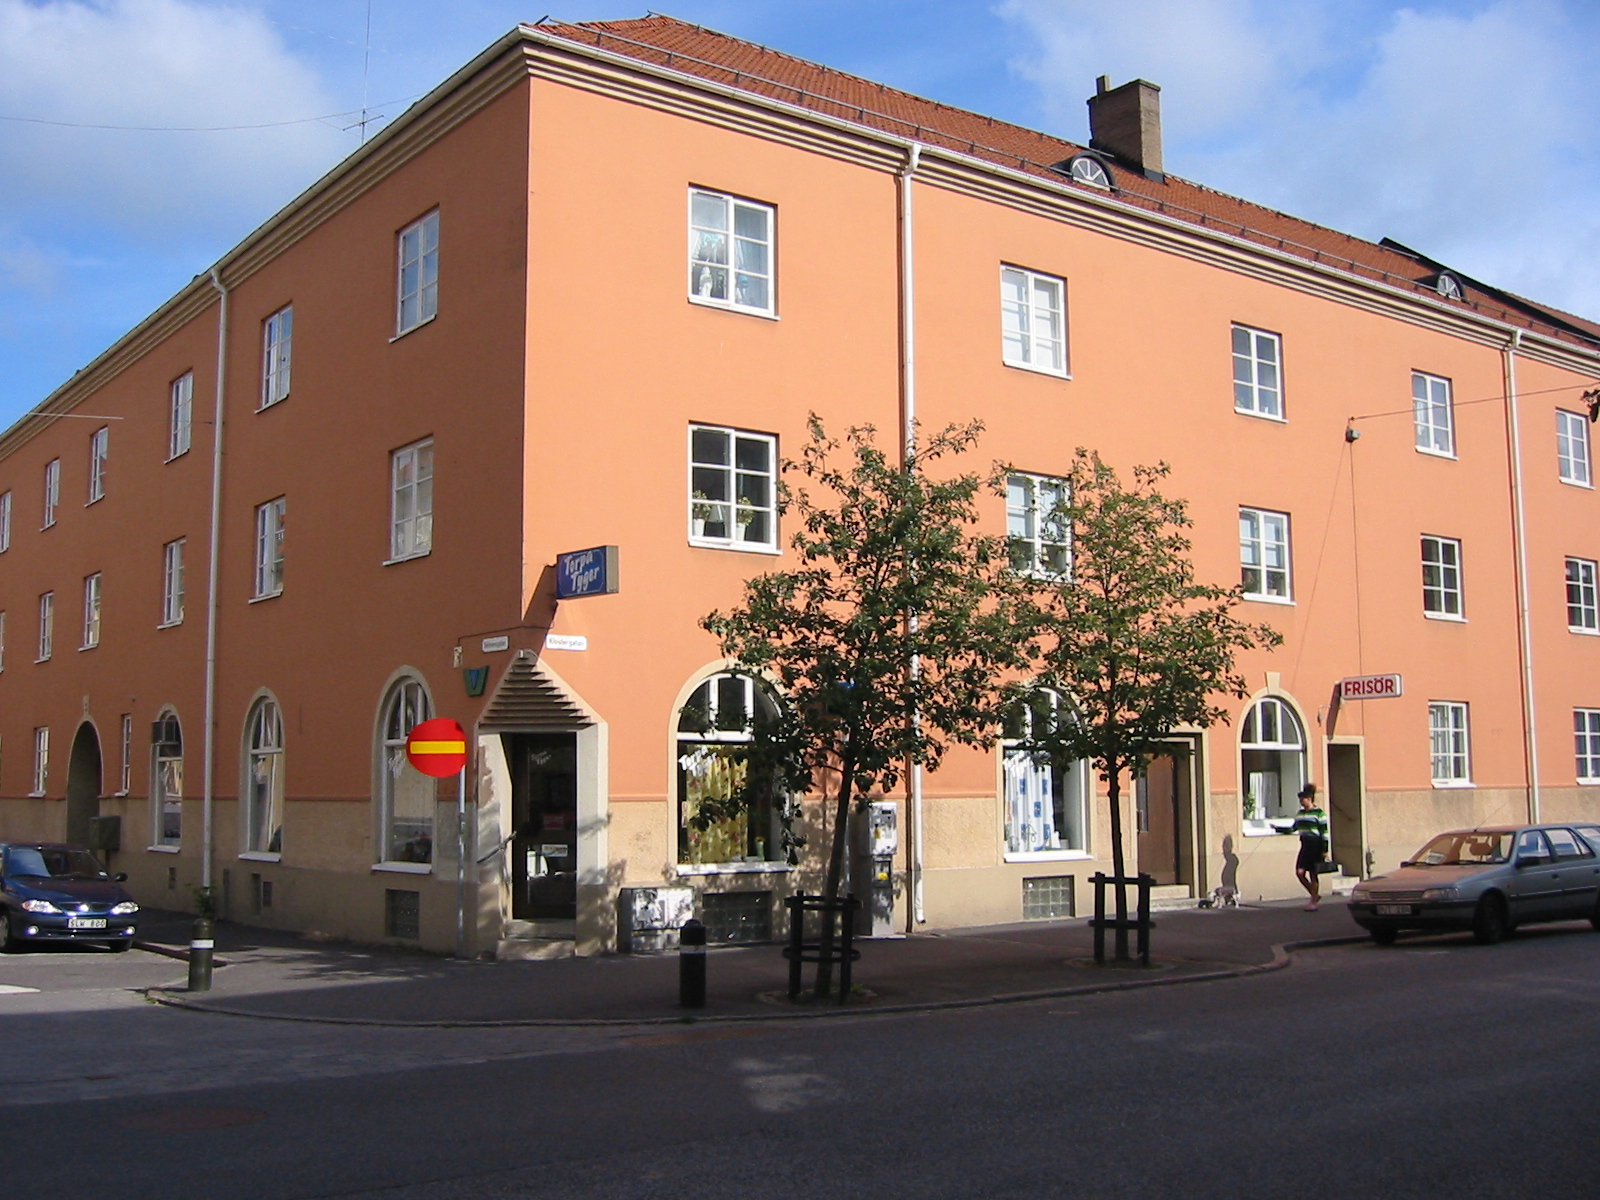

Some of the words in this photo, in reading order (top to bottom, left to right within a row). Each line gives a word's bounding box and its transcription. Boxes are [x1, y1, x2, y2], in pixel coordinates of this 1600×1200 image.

[564, 550, 594, 576] Torpa
[570, 566, 600, 595] Tyger
[1344, 677, 1394, 696] FRISÖR
